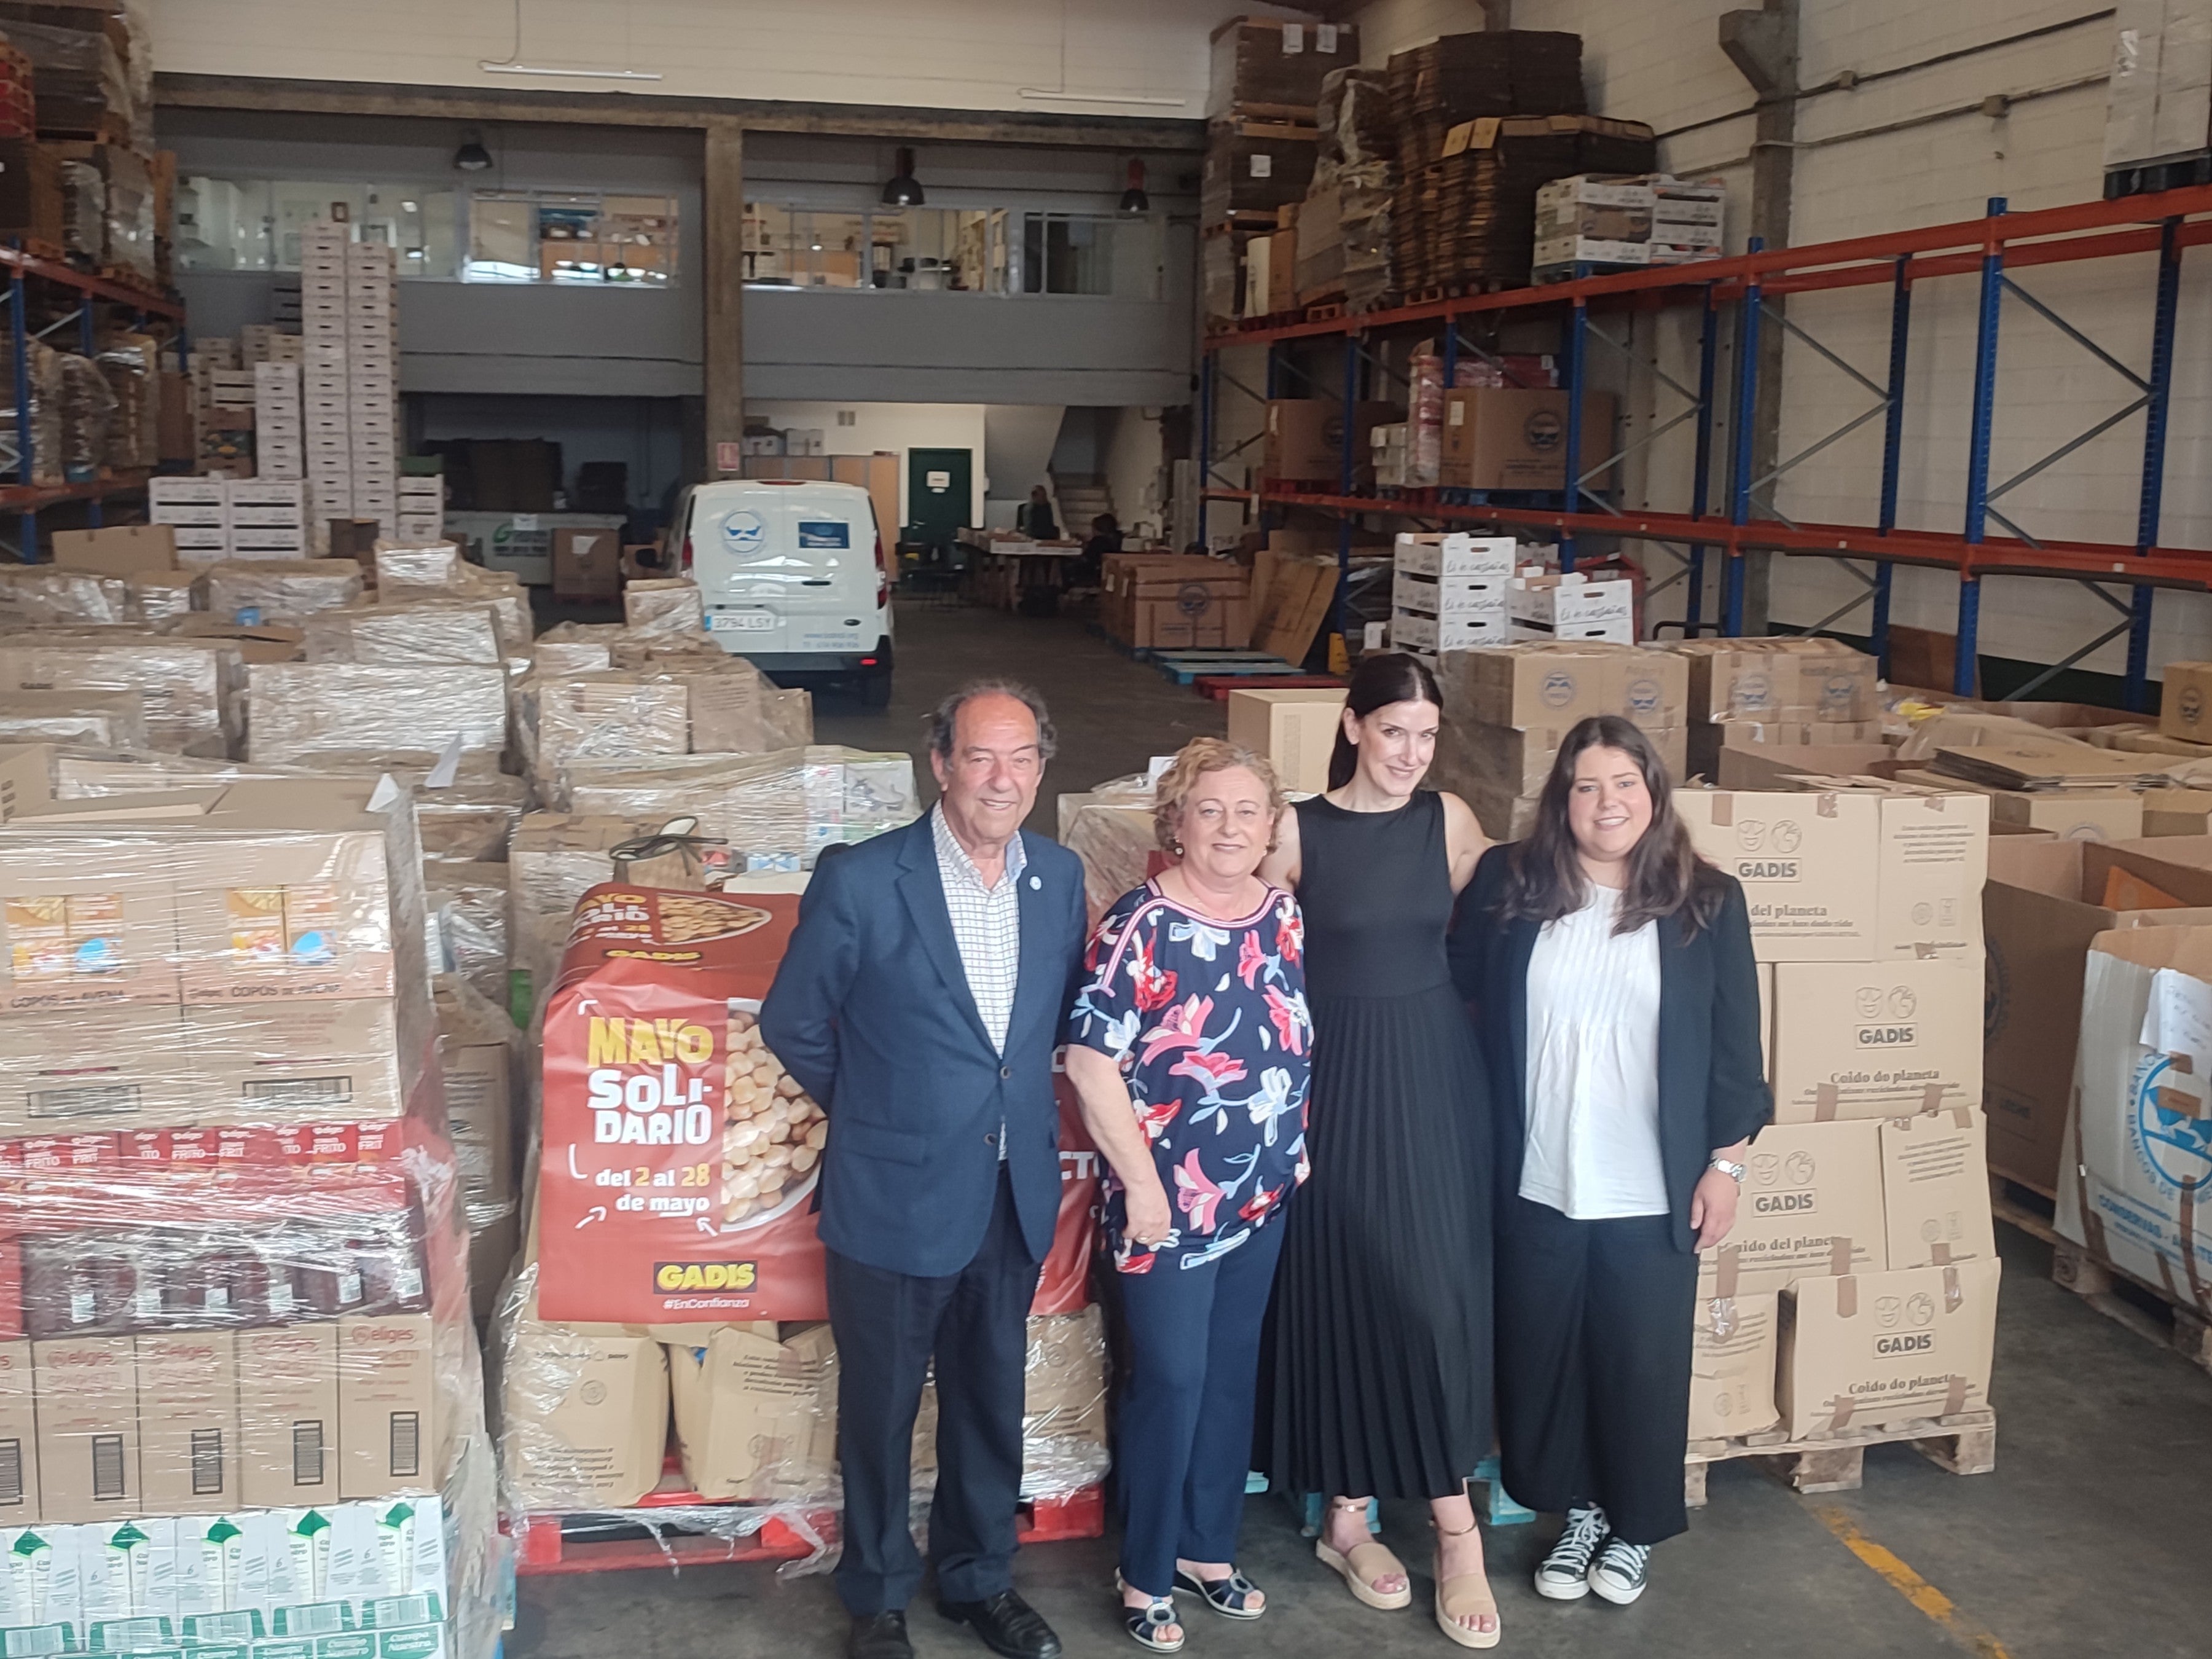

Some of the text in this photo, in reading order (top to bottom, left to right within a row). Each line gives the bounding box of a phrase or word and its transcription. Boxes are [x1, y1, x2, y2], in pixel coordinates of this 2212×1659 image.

[715, 616, 771, 628] 3794 LSY
[1738, 862, 1797, 878] GADIS
[1751, 904, 1827, 919] del planeta
[605, 950, 700, 960] GADIS
[231, 986, 278, 997] COPOS
[587, 1017, 714, 1069] MAYO
[1859, 1027, 1915, 1045] GADIS
[1830, 1069, 1940, 1084] Coido do planeta
[587, 1063, 713, 1112] SOLI-
[594, 1104, 713, 1145] DARIO
[219, 1147, 244, 1158] FRIT
[358, 1139, 383, 1150] FRIT
[595, 1163, 711, 1187] del 2 al 28
[616, 1194, 710, 1214] de mayo
[1755, 1193, 1814, 1212] GADIS
[1770, 1237, 1790, 1251] del
[1794, 1235, 1835, 1252] plane
[656, 1263, 755, 1291] GADIS
[662, 1297, 751, 1310] #EnConfianza
[371, 1326, 417, 1344] eliges
[1876, 1334, 1932, 1354] GADIS
[68, 1350, 114, 1366] eliges
[1848, 1381, 1888, 1395] Coido
[1889, 1377, 1906, 1390] do
